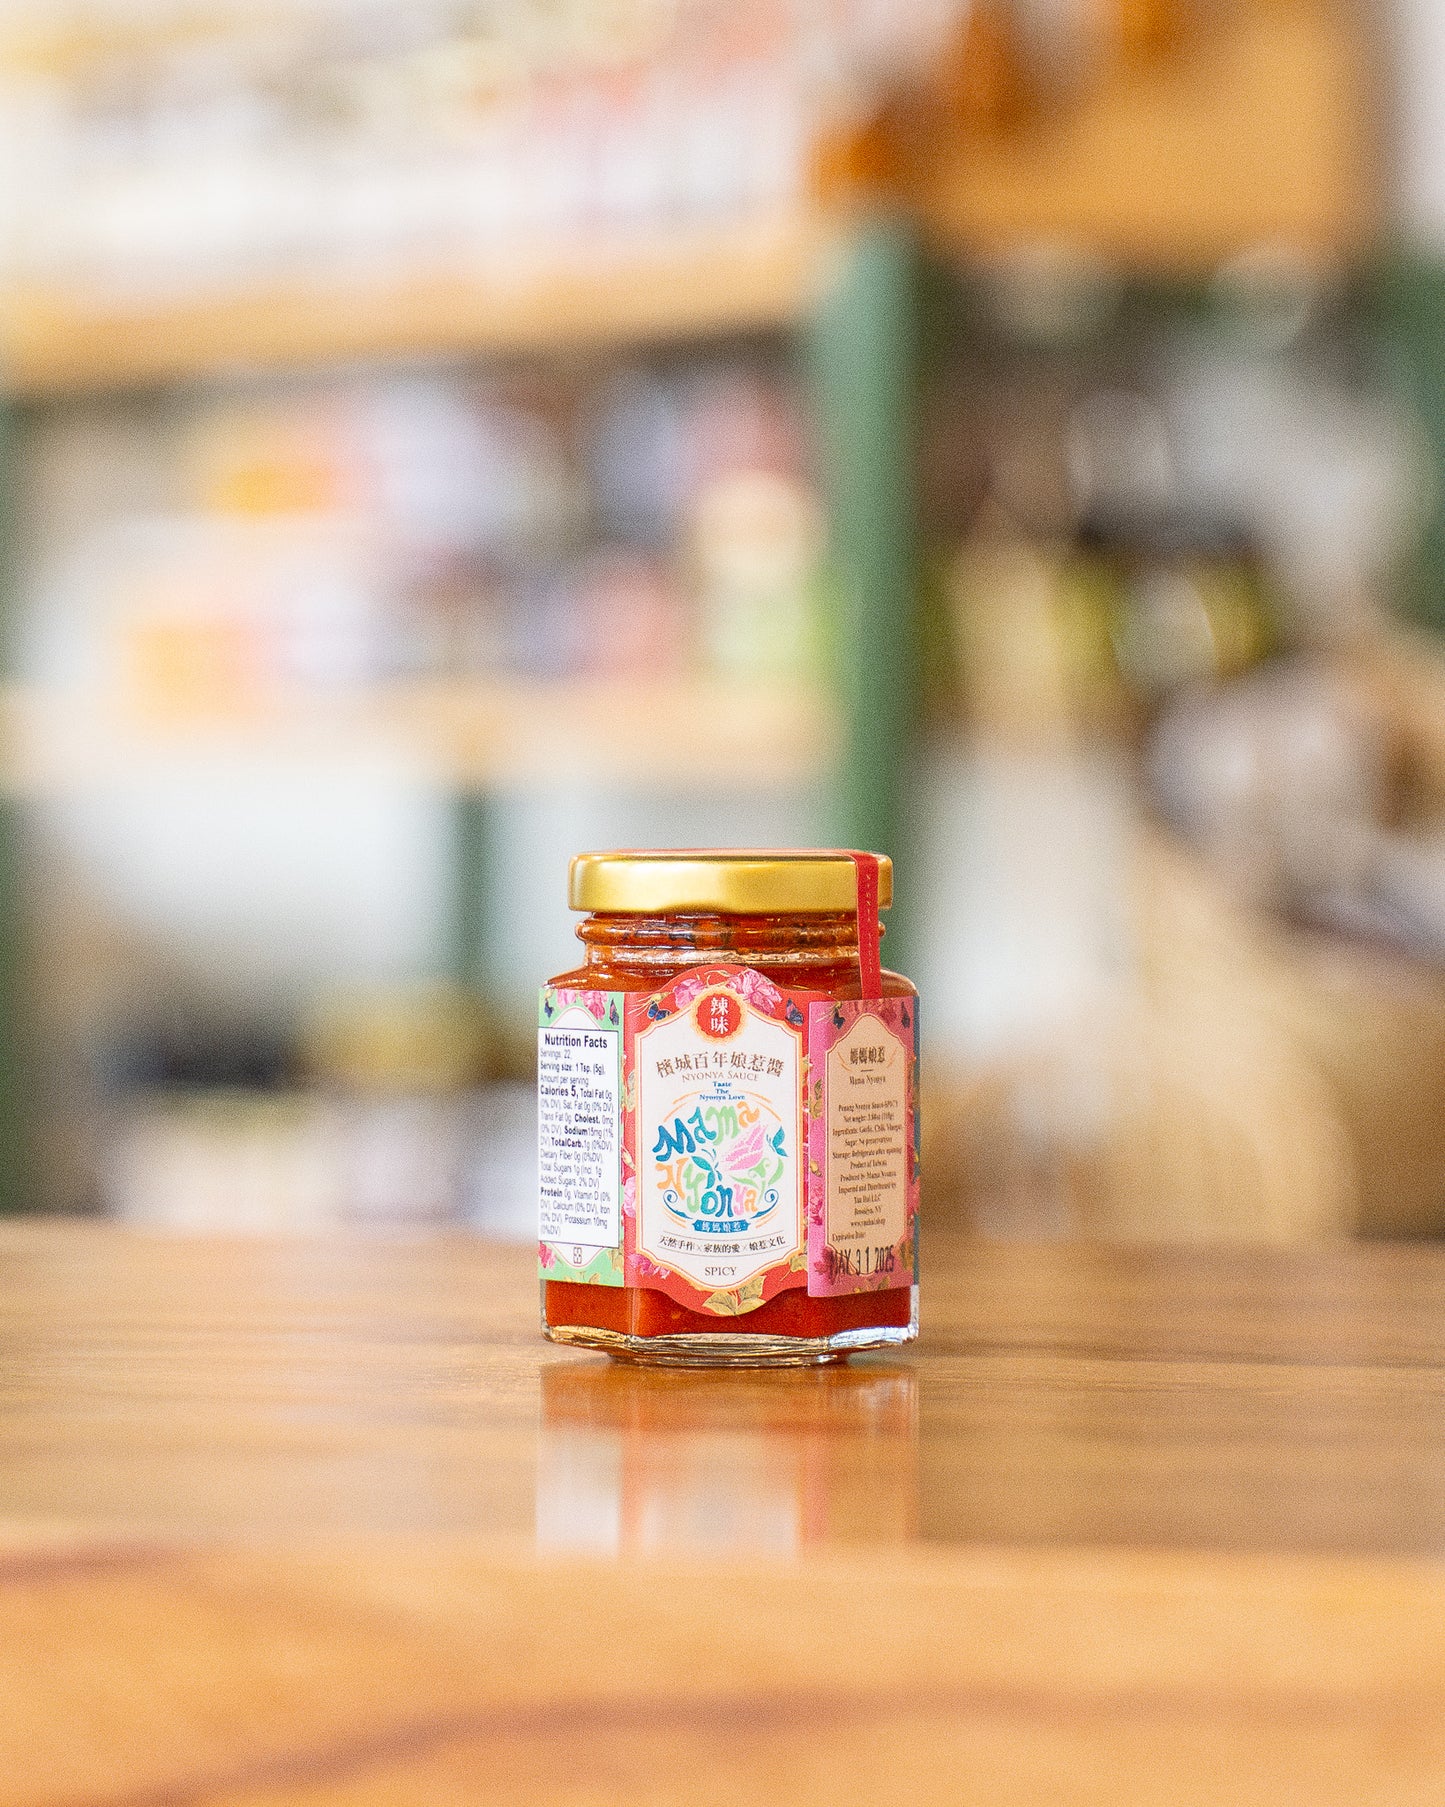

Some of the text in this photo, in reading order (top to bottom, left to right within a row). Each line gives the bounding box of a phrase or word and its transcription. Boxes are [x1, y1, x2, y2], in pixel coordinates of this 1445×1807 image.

[711, 998, 728, 1034] 辣味
[545, 1033, 607, 1048] Nutrition Facts
[540, 1060, 560, 1072] Serving
[682, 1071, 724, 1082] NYONYA
[540, 1084, 568, 1096] Calories
[580, 1088, 594, 1098] Total
[595, 1089, 604, 1099] Fat
[540, 1186, 562, 1197] Protein
[875, 1245, 894, 1273] 2025
[705, 1267, 736, 1276] SPICY
